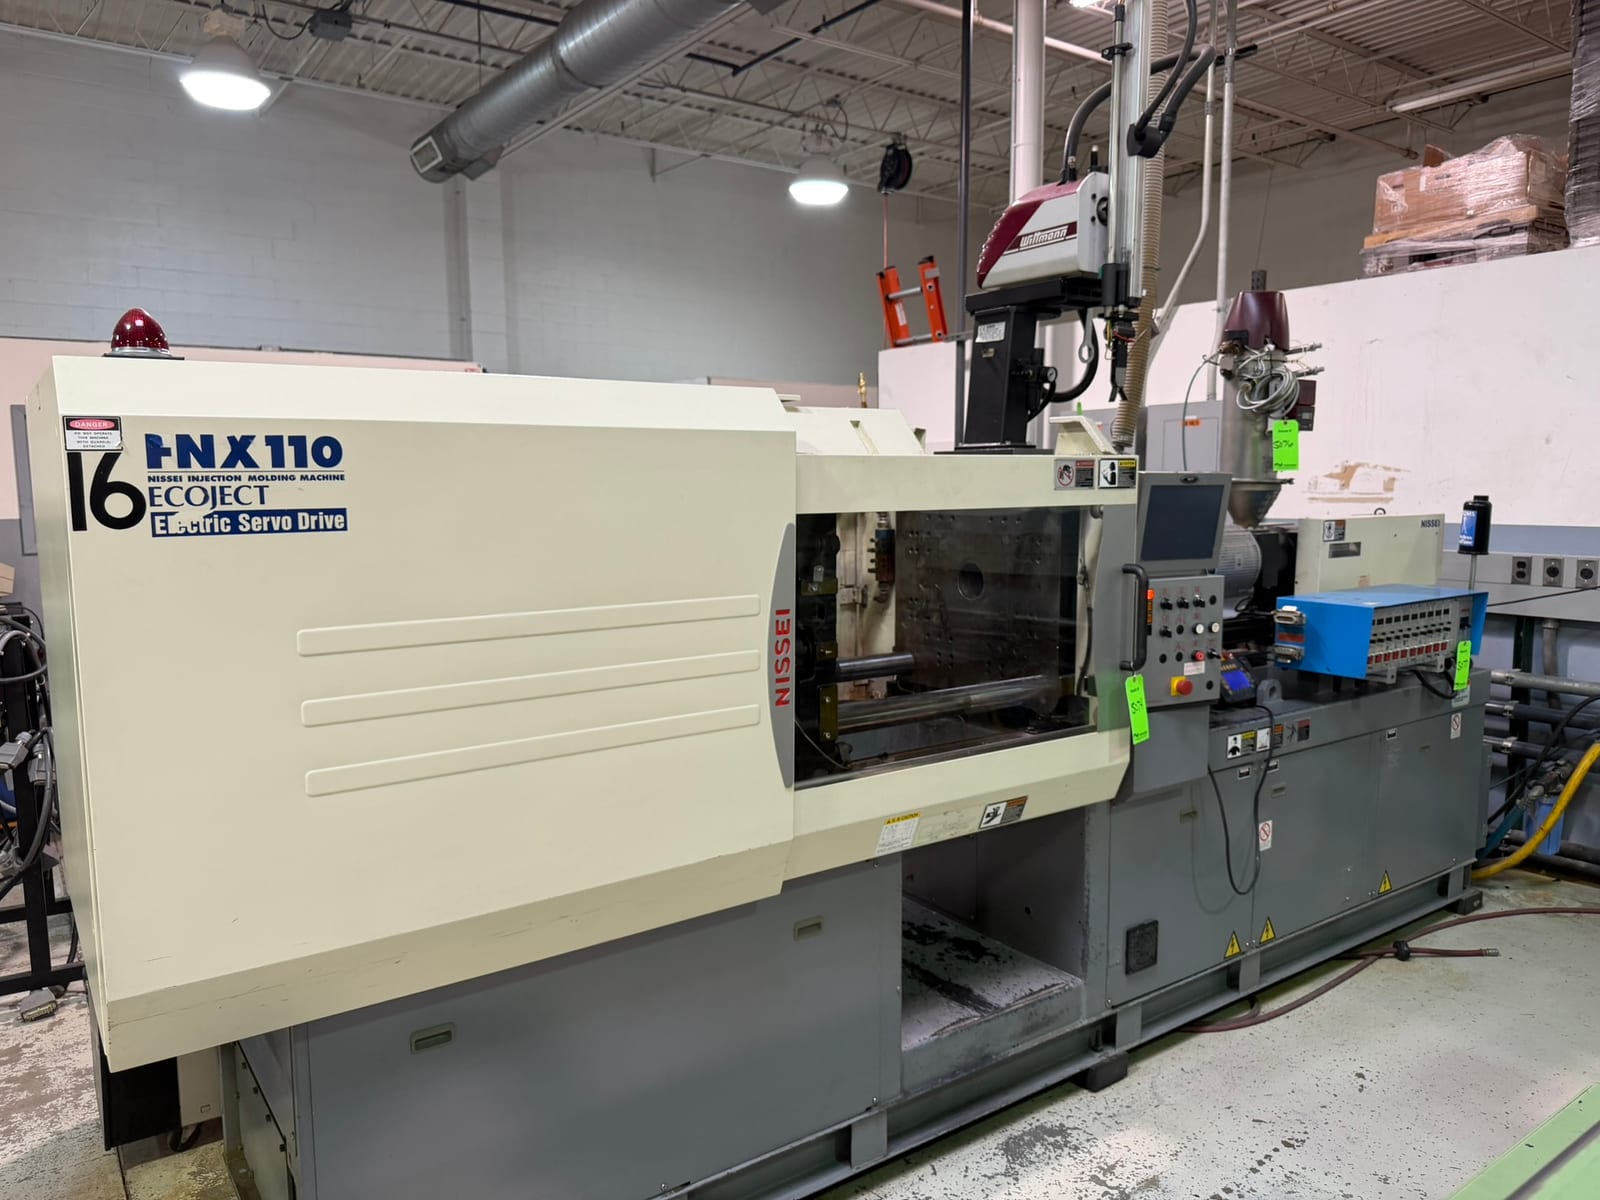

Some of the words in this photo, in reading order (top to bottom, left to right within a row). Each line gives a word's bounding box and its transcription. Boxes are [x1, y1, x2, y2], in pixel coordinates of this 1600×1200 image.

[74, 421, 108, 429] DANGER
[147, 475, 183, 483] NISSEI
[187, 474, 242, 482] INJECTION
[67, 452, 147, 531] 16
[148, 485, 269, 510] ECOJECT
[238, 513, 293, 532] Servo
[297, 511, 345, 530] Drive
[1421, 519, 1441, 528] NISSEI
[775, 608, 791, 706] NISSEI
